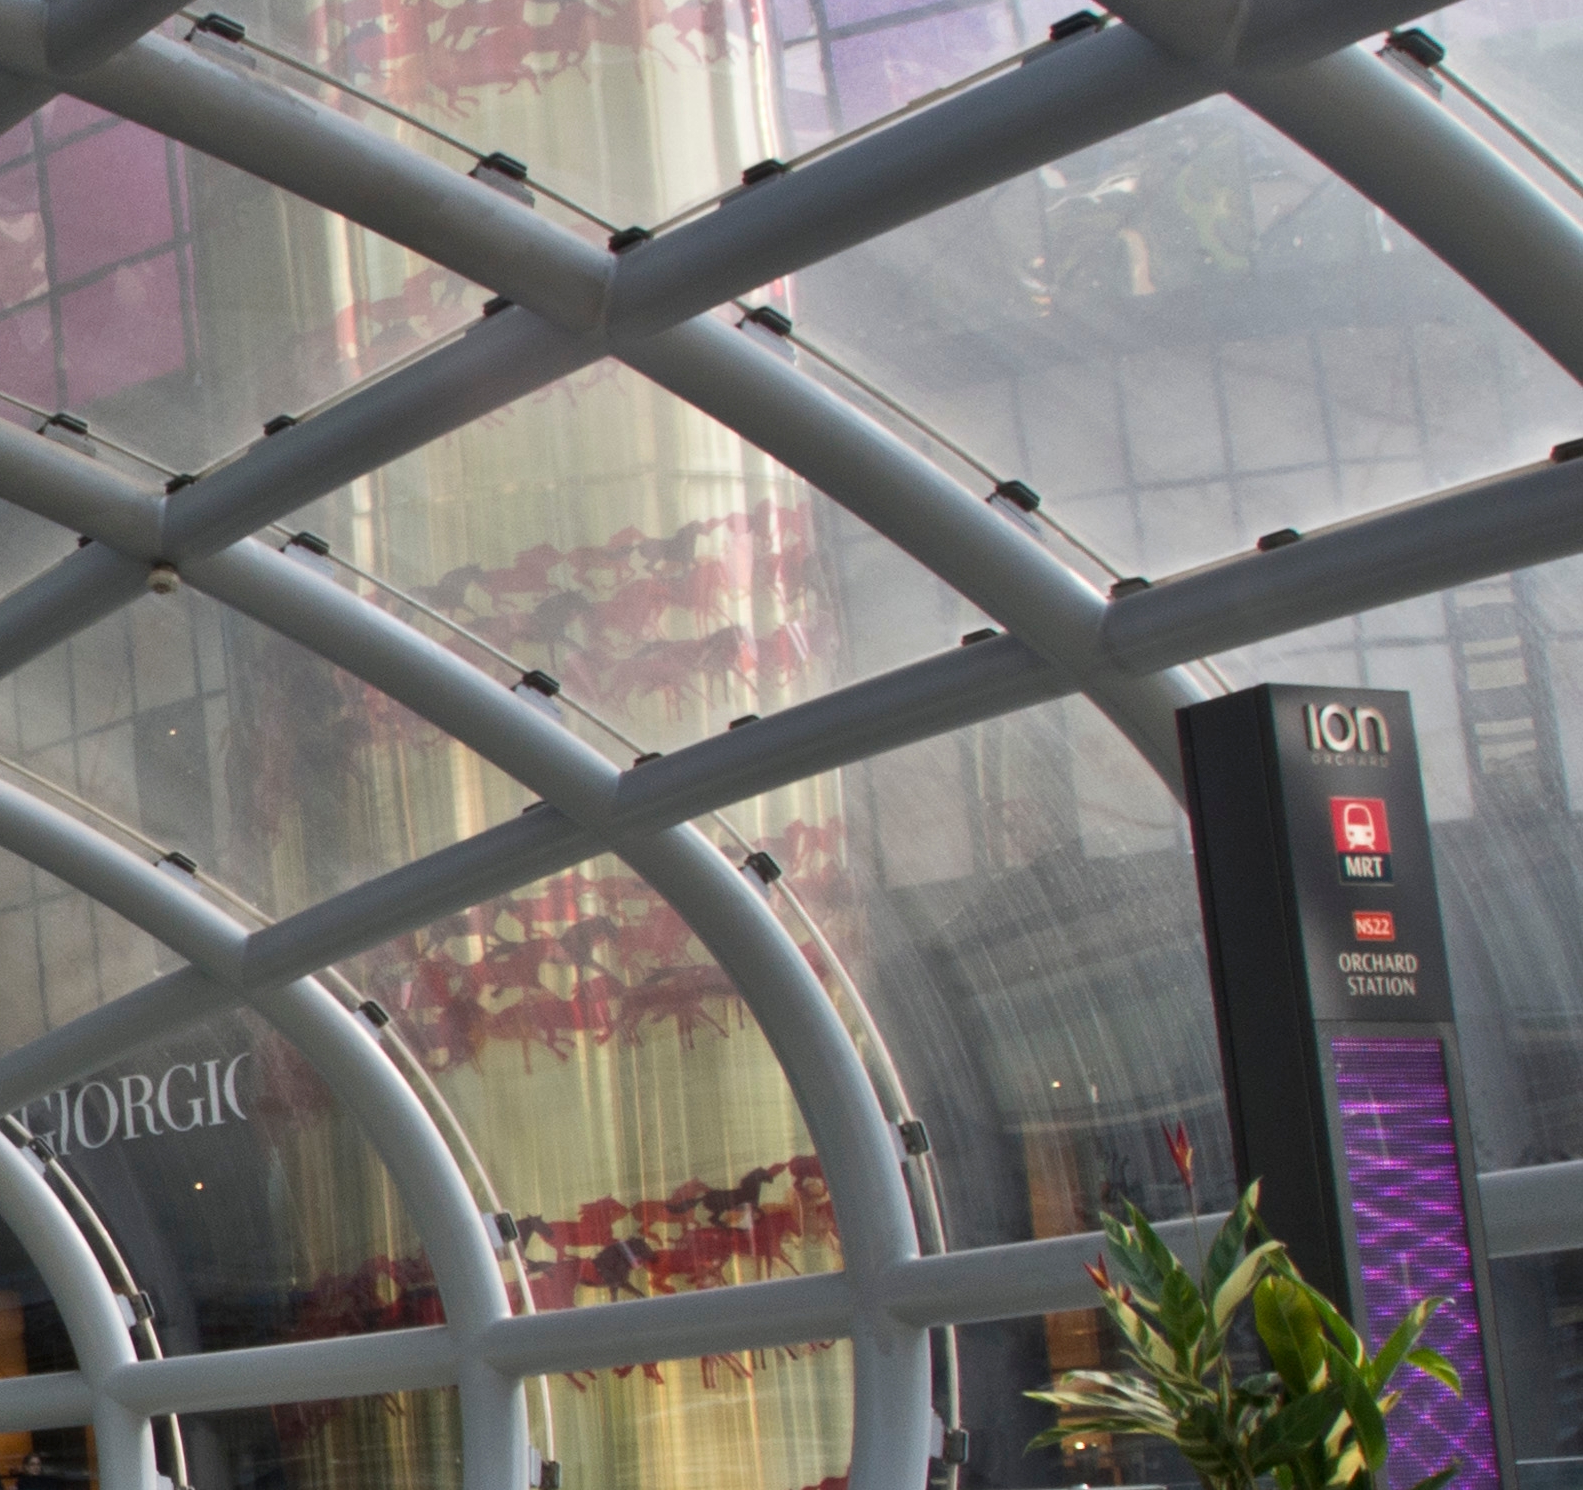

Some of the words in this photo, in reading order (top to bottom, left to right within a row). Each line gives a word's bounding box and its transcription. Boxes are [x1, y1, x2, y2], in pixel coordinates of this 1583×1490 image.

[1311, 754, 1390, 768] ORCHARD
[1345, 856, 1384, 878] MRT
[1355, 917, 1391, 936] NS22
[1339, 953, 1419, 974] ORCHARD
[1347, 977, 1416, 996] STATION
